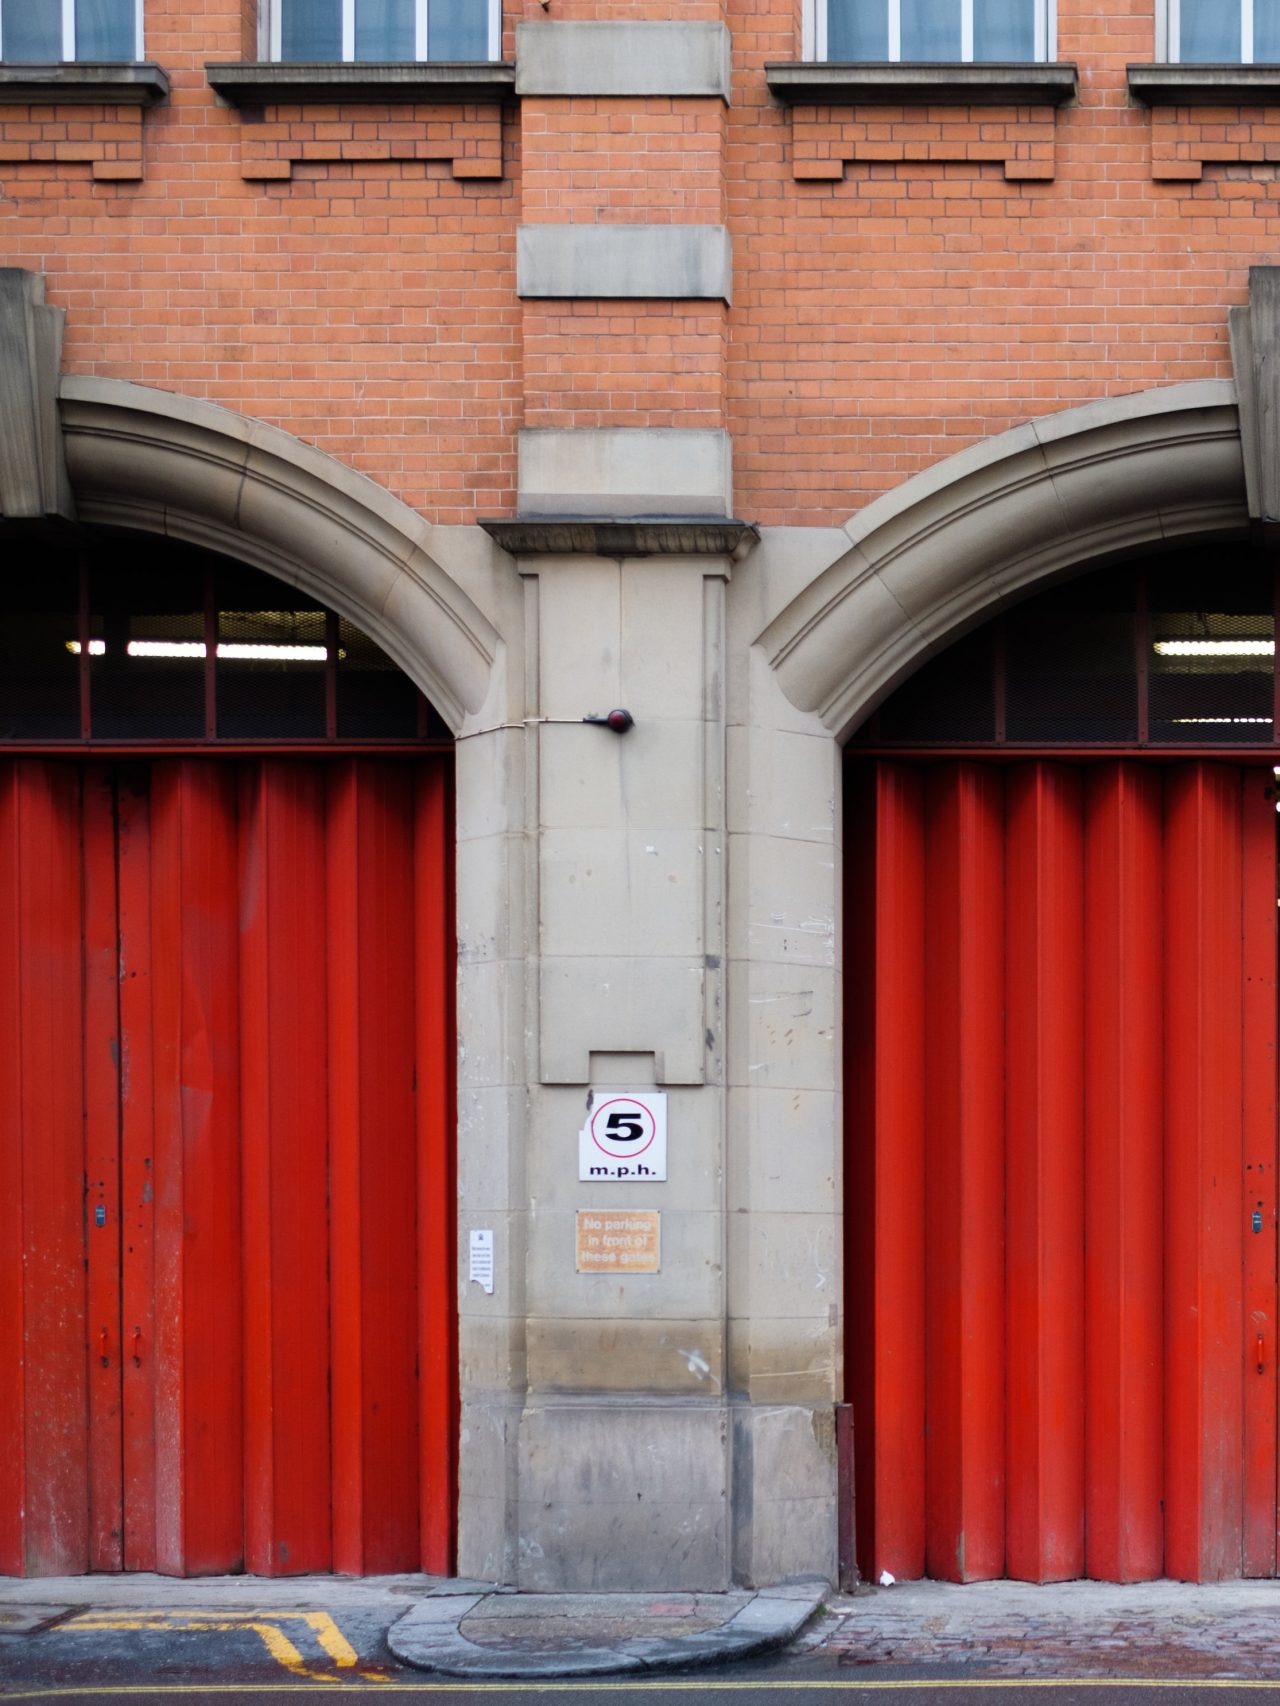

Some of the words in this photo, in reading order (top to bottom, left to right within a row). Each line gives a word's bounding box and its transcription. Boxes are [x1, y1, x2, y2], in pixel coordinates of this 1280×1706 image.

[605, 1113, 644, 1141] 5
[590, 1164, 656, 1178] m.p.h.
[584, 1218, 602, 1230] No
[604, 1218, 651, 1231] parking
[588, 1234, 599, 1246] in
[603, 1234, 632, 1246] front
[634, 1234, 647, 1247] of
[582, 1251, 617, 1262] these
